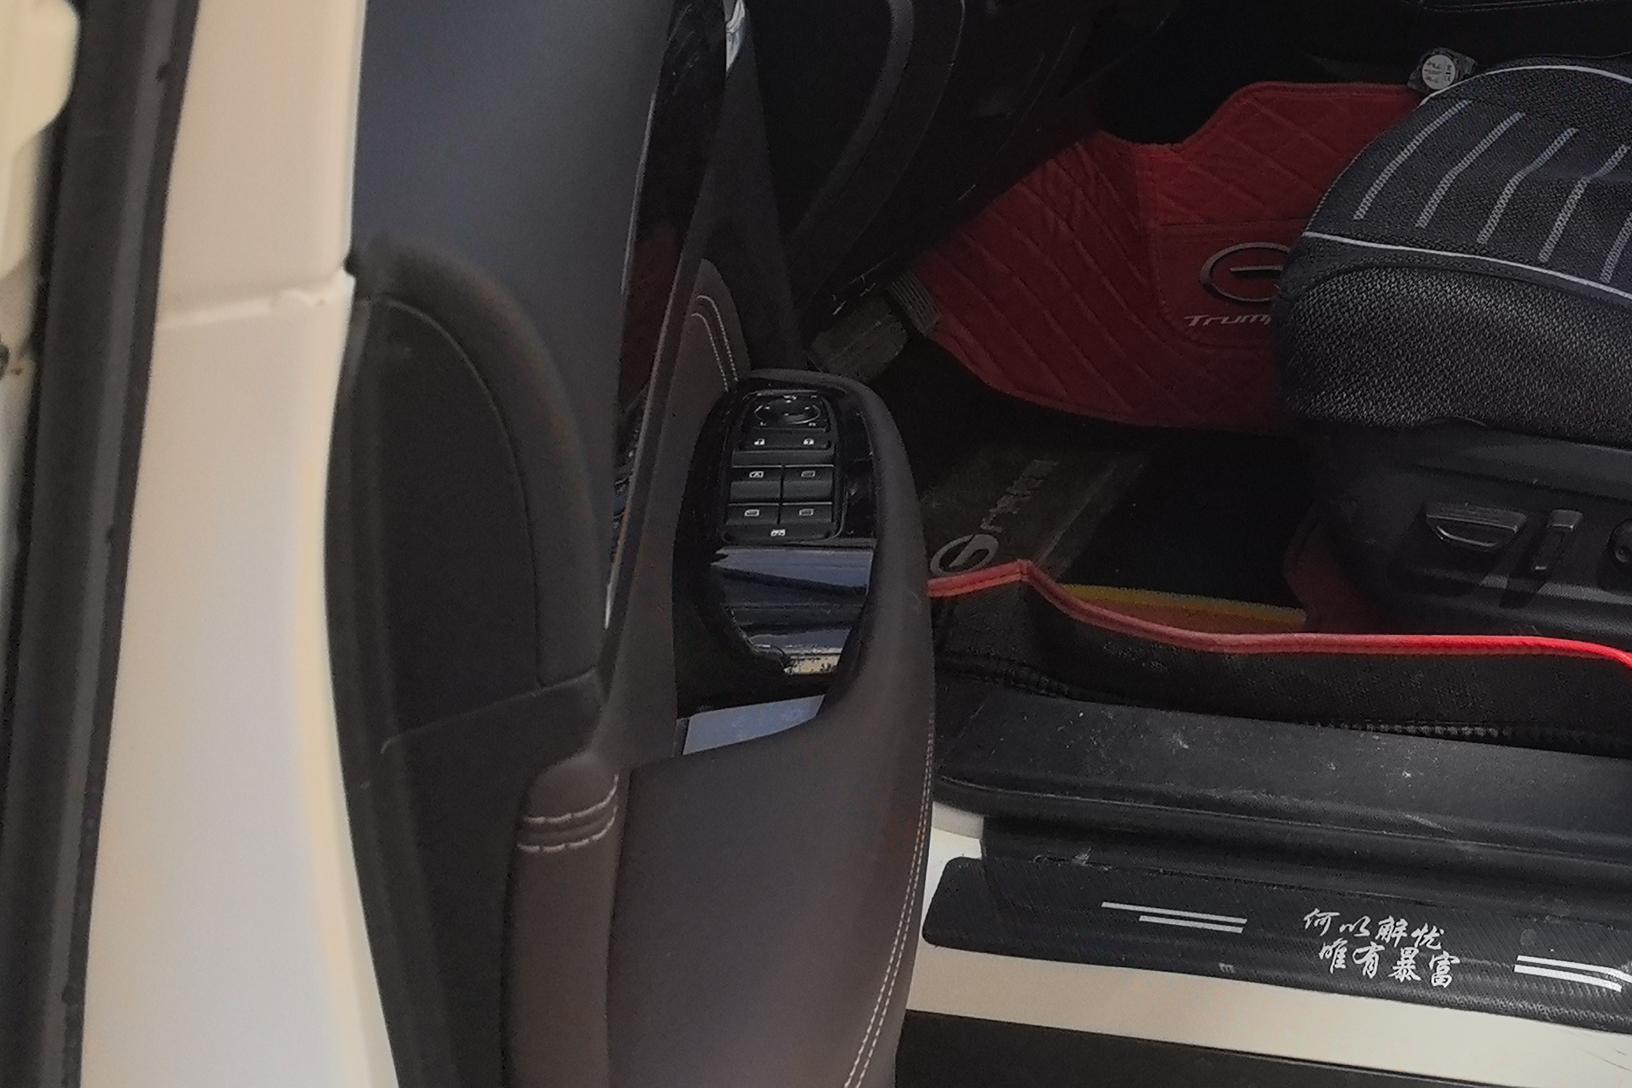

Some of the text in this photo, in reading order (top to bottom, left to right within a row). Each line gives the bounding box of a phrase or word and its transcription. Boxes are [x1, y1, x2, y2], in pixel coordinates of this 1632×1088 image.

[1183, 313, 1272, 327] Trum
[1303, 907, 1445, 951] 何以解忧
[1318, 937, 1461, 989] 唯有暴富
